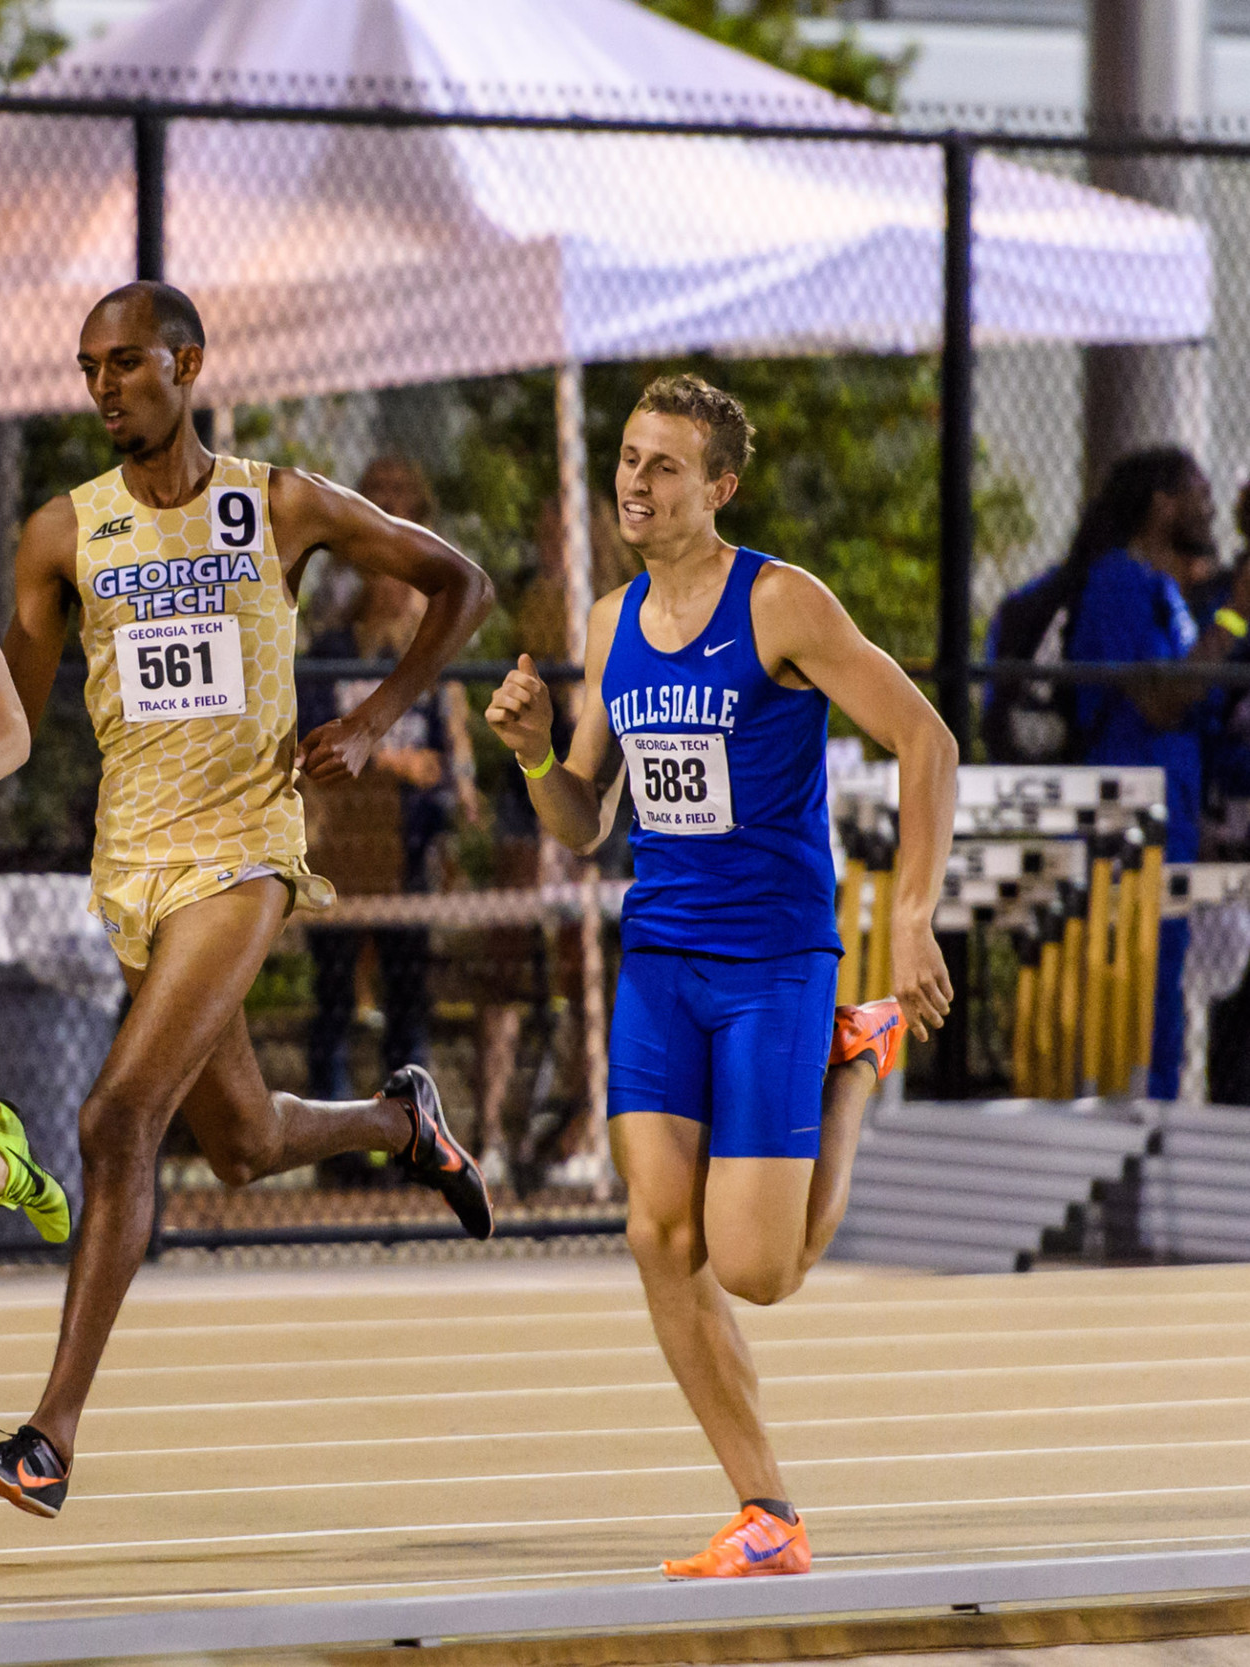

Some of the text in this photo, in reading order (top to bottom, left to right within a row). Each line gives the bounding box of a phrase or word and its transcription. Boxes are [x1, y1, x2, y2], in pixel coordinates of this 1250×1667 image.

[88, 515, 135, 541] ACC
[218, 491, 256, 547] 9
[94, 553, 261, 599] GEORGIA
[127, 584, 226, 622] TECH
[128, 622, 223, 641] GEORGIA TECH
[137, 641, 214, 690] 561
[138, 694, 227, 712] TRACK & FIELD
[610, 685, 739, 737] HILLSDALE
[635, 739, 709, 751] GEORGIA TECH
[643, 757, 708, 803] 583
[646, 811, 716, 825] TRACK & FIELD
